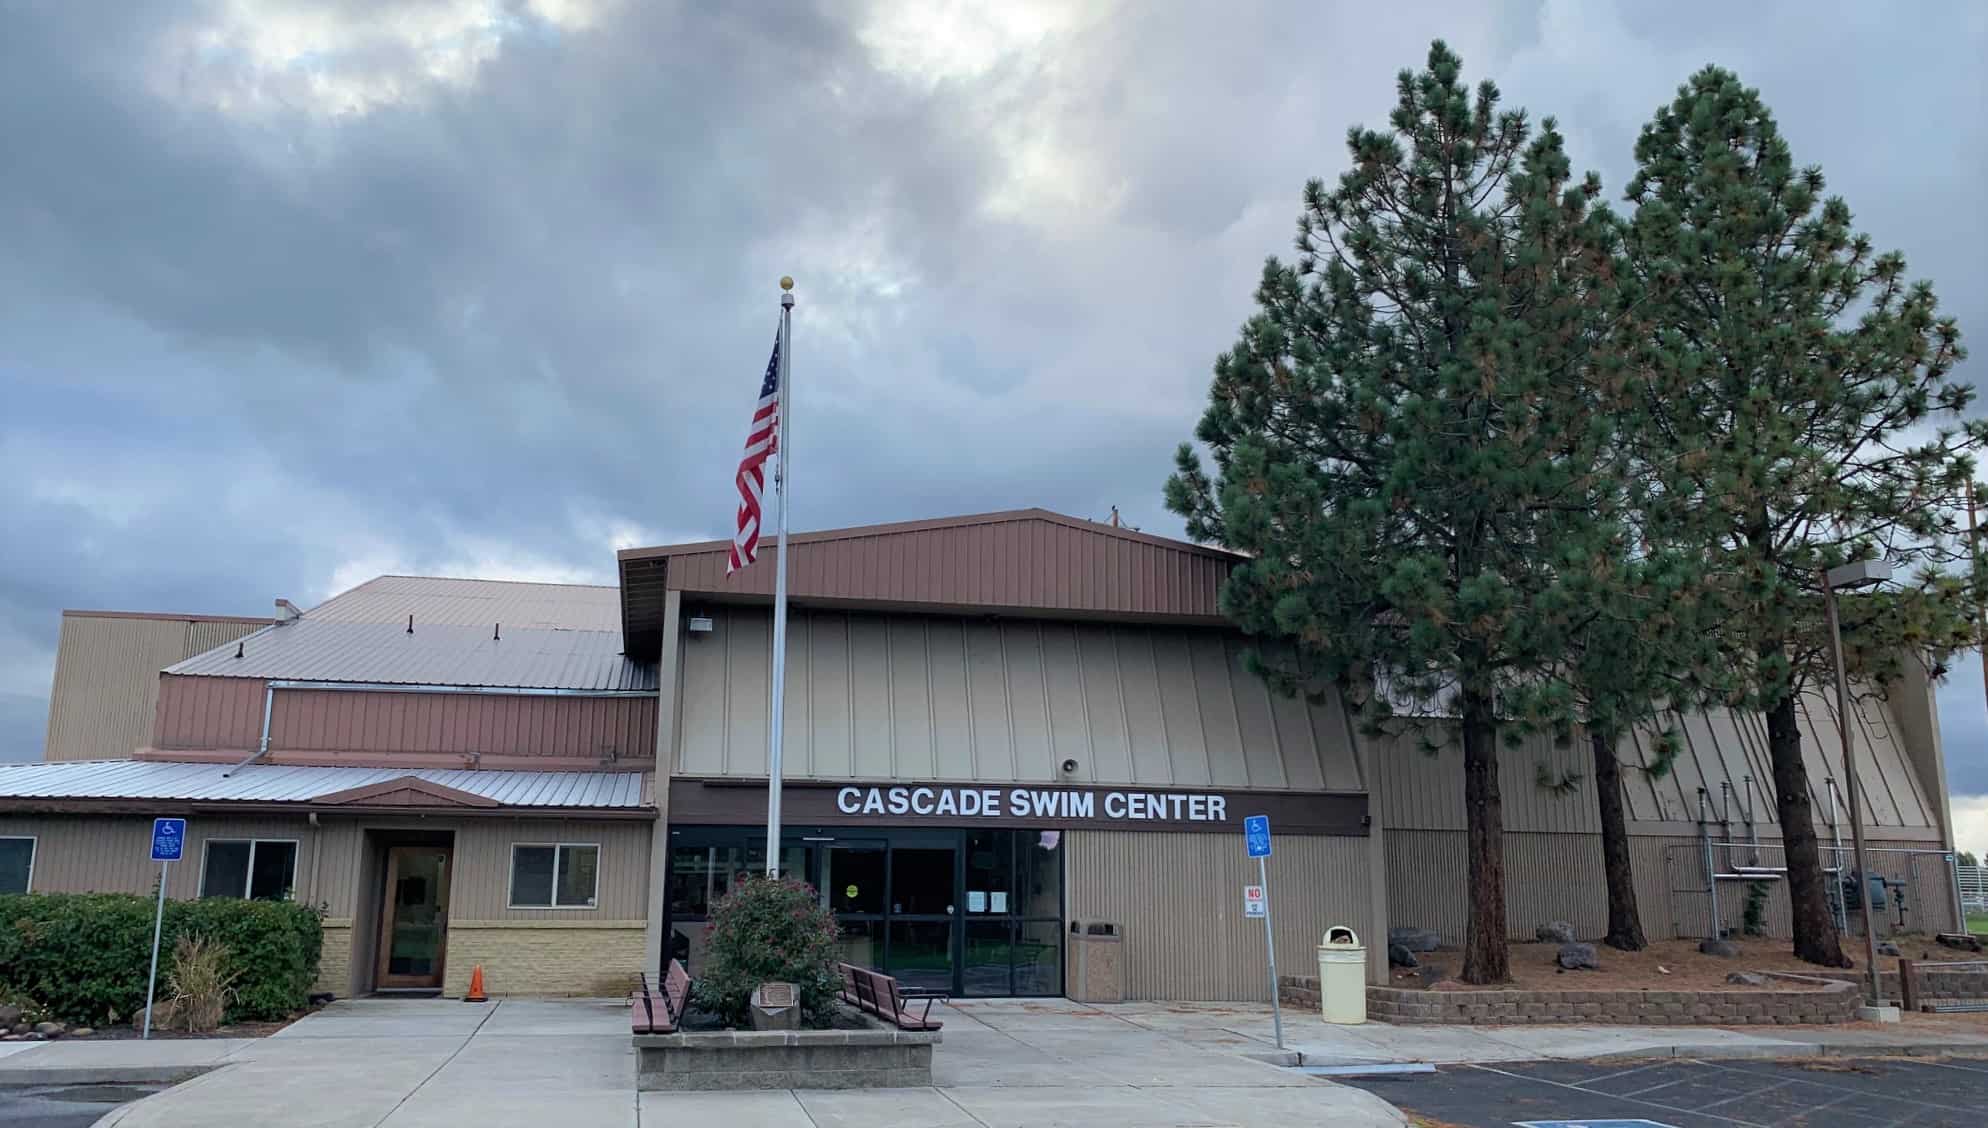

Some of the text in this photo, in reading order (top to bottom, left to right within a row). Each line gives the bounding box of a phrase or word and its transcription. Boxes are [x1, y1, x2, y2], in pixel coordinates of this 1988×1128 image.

[837, 787, 1226, 821] CASCADE SWIM CENTER
[1248, 888, 1261, 898] NO
